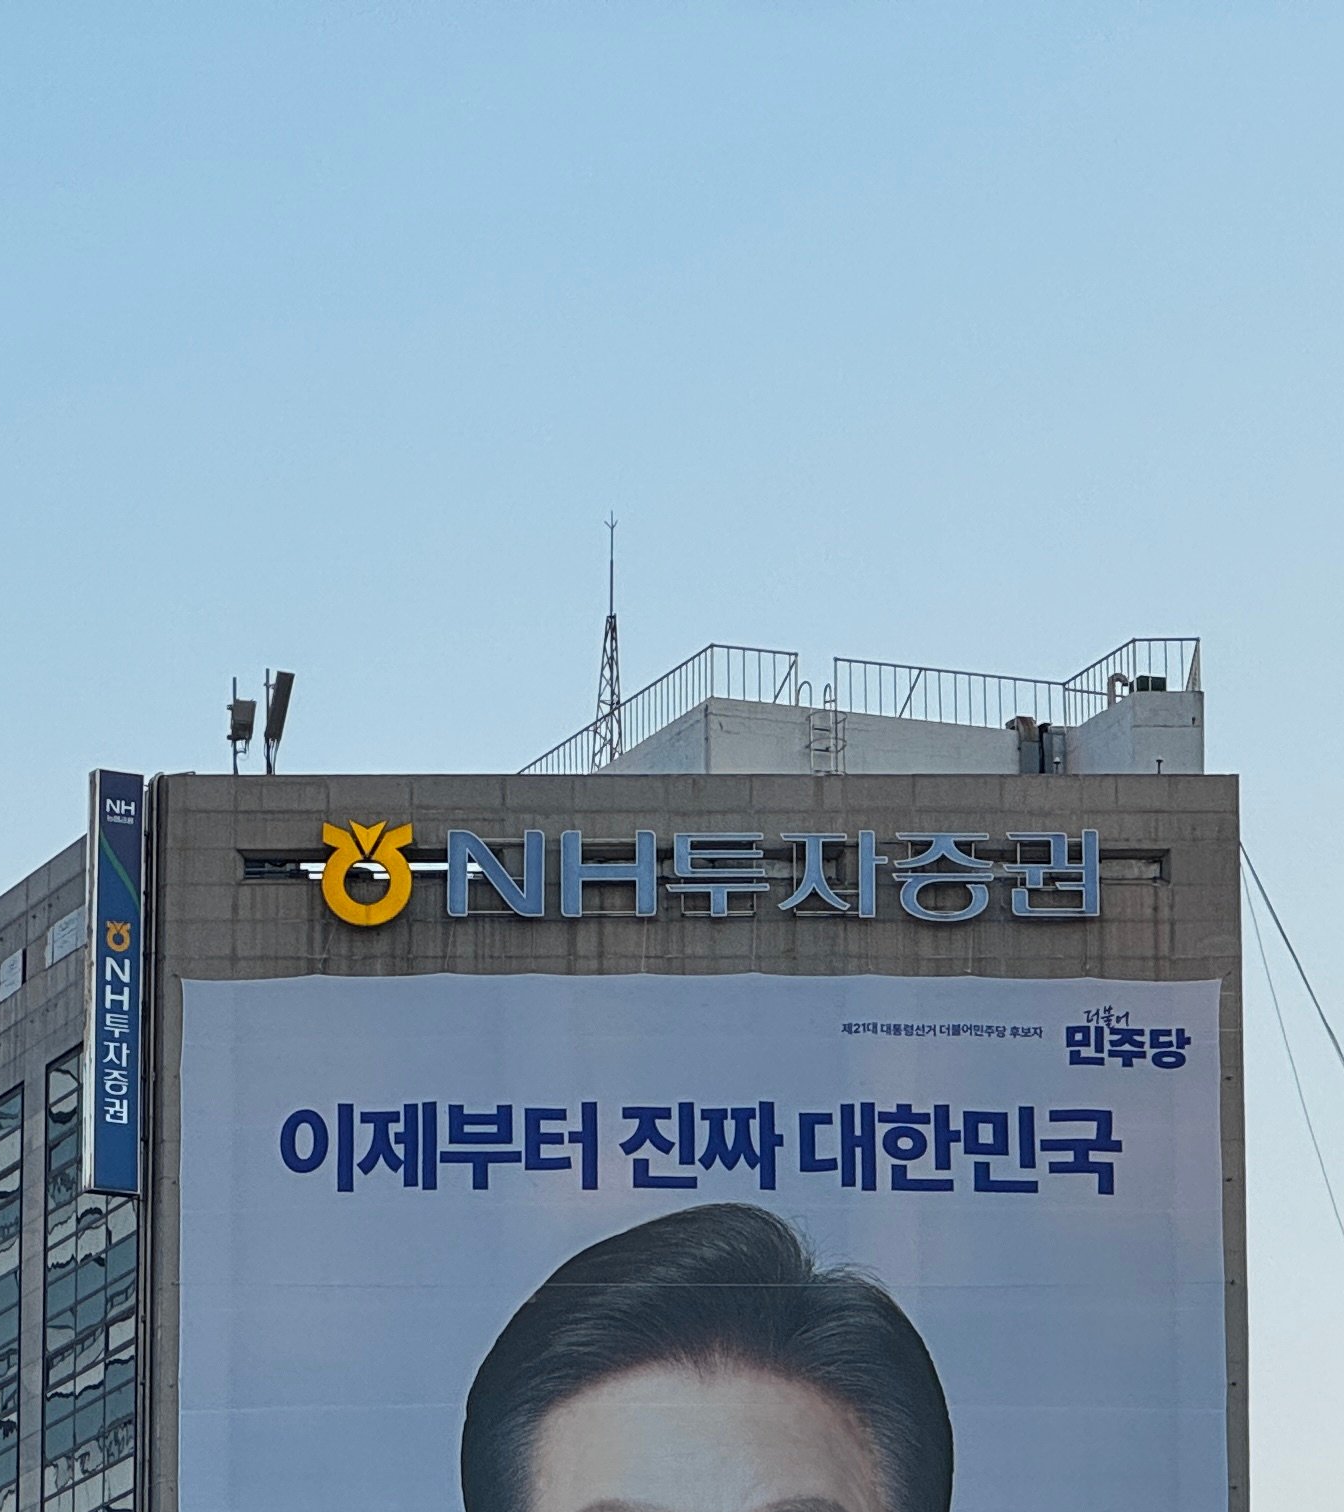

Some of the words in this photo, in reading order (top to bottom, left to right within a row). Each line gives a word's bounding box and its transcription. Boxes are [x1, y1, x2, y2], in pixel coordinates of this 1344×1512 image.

[106, 799, 135, 815] NH
[446, 828, 1102, 921] NH투자증권
[841, 1022, 878, 1035] 제21대
[880, 1023, 937, 1037] 대통령선거
[939, 1024, 1007, 1038] 더불어민주당
[1009, 1025, 1043, 1039] 후보자
[1084, 1006, 1130, 1028] 더불어
[103, 956, 131, 1124] NH투자증권
[1065, 1025, 1191, 1069] 민주당
[280, 1102, 598, 1191] 이제부터
[619, 1102, 783, 1191] 진짜
[798, 1103, 1123, 1195] 대한민국
